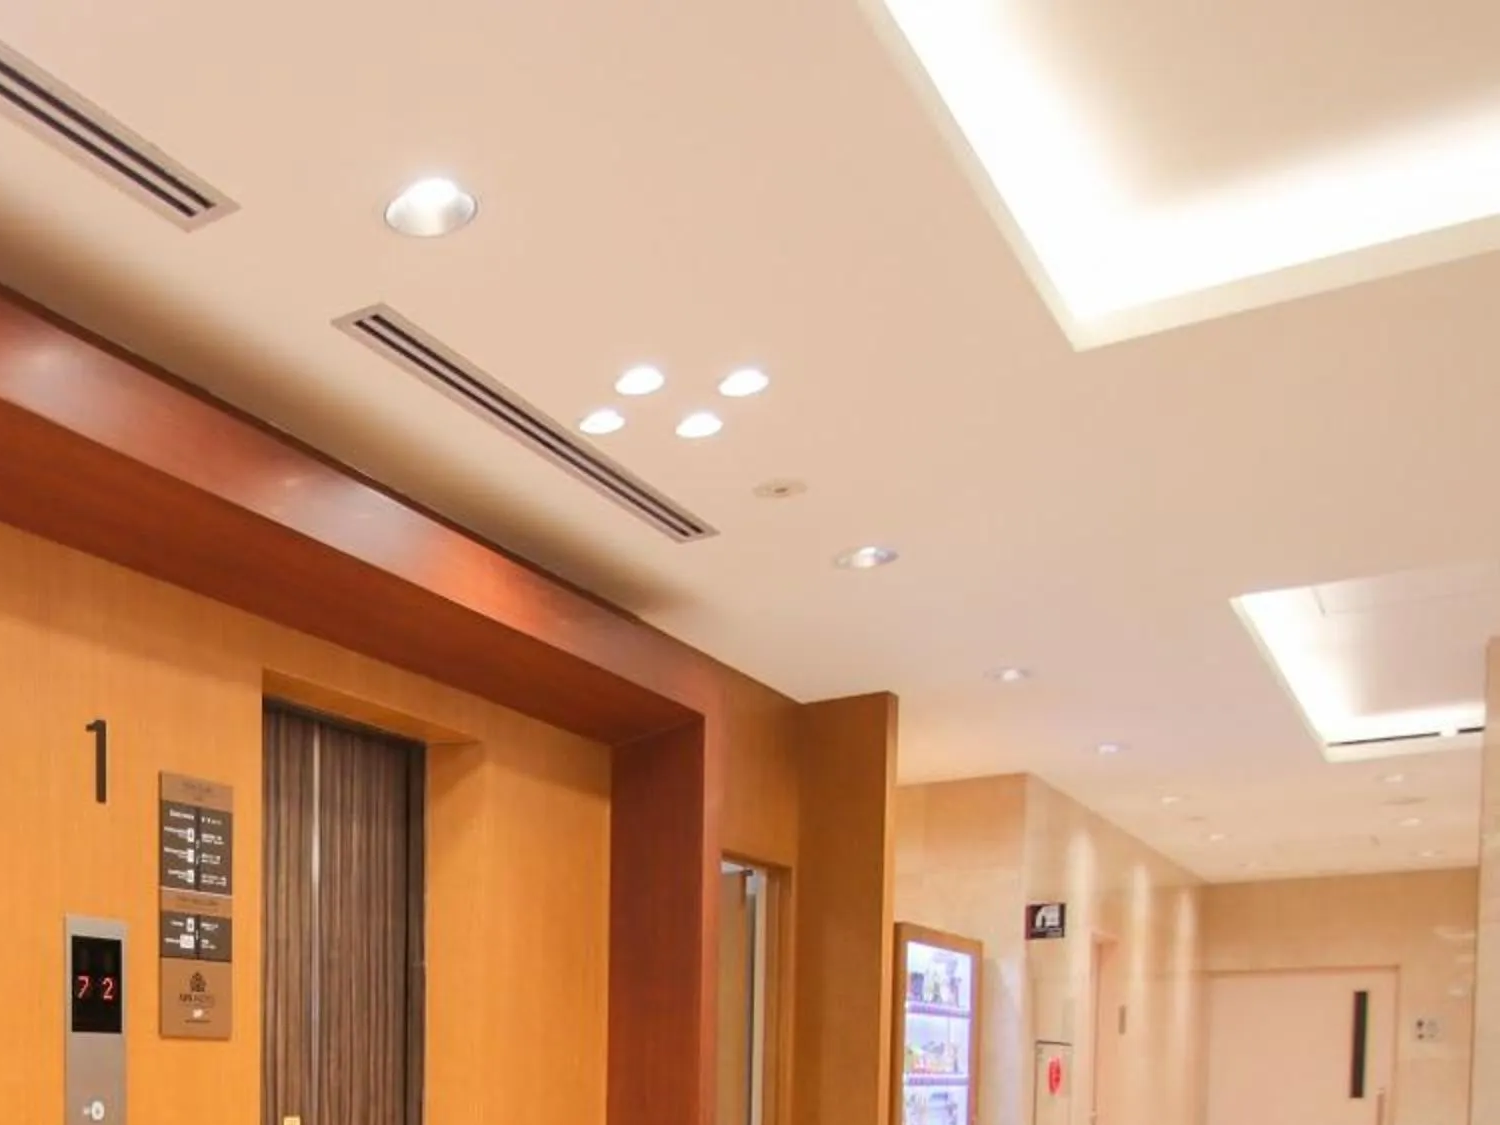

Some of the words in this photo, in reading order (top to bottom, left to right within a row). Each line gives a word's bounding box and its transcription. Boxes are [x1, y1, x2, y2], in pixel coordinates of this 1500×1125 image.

[85, 719, 106, 804] 1
[77, 975, 89, 999] 7
[102, 977, 113, 1001] 2
